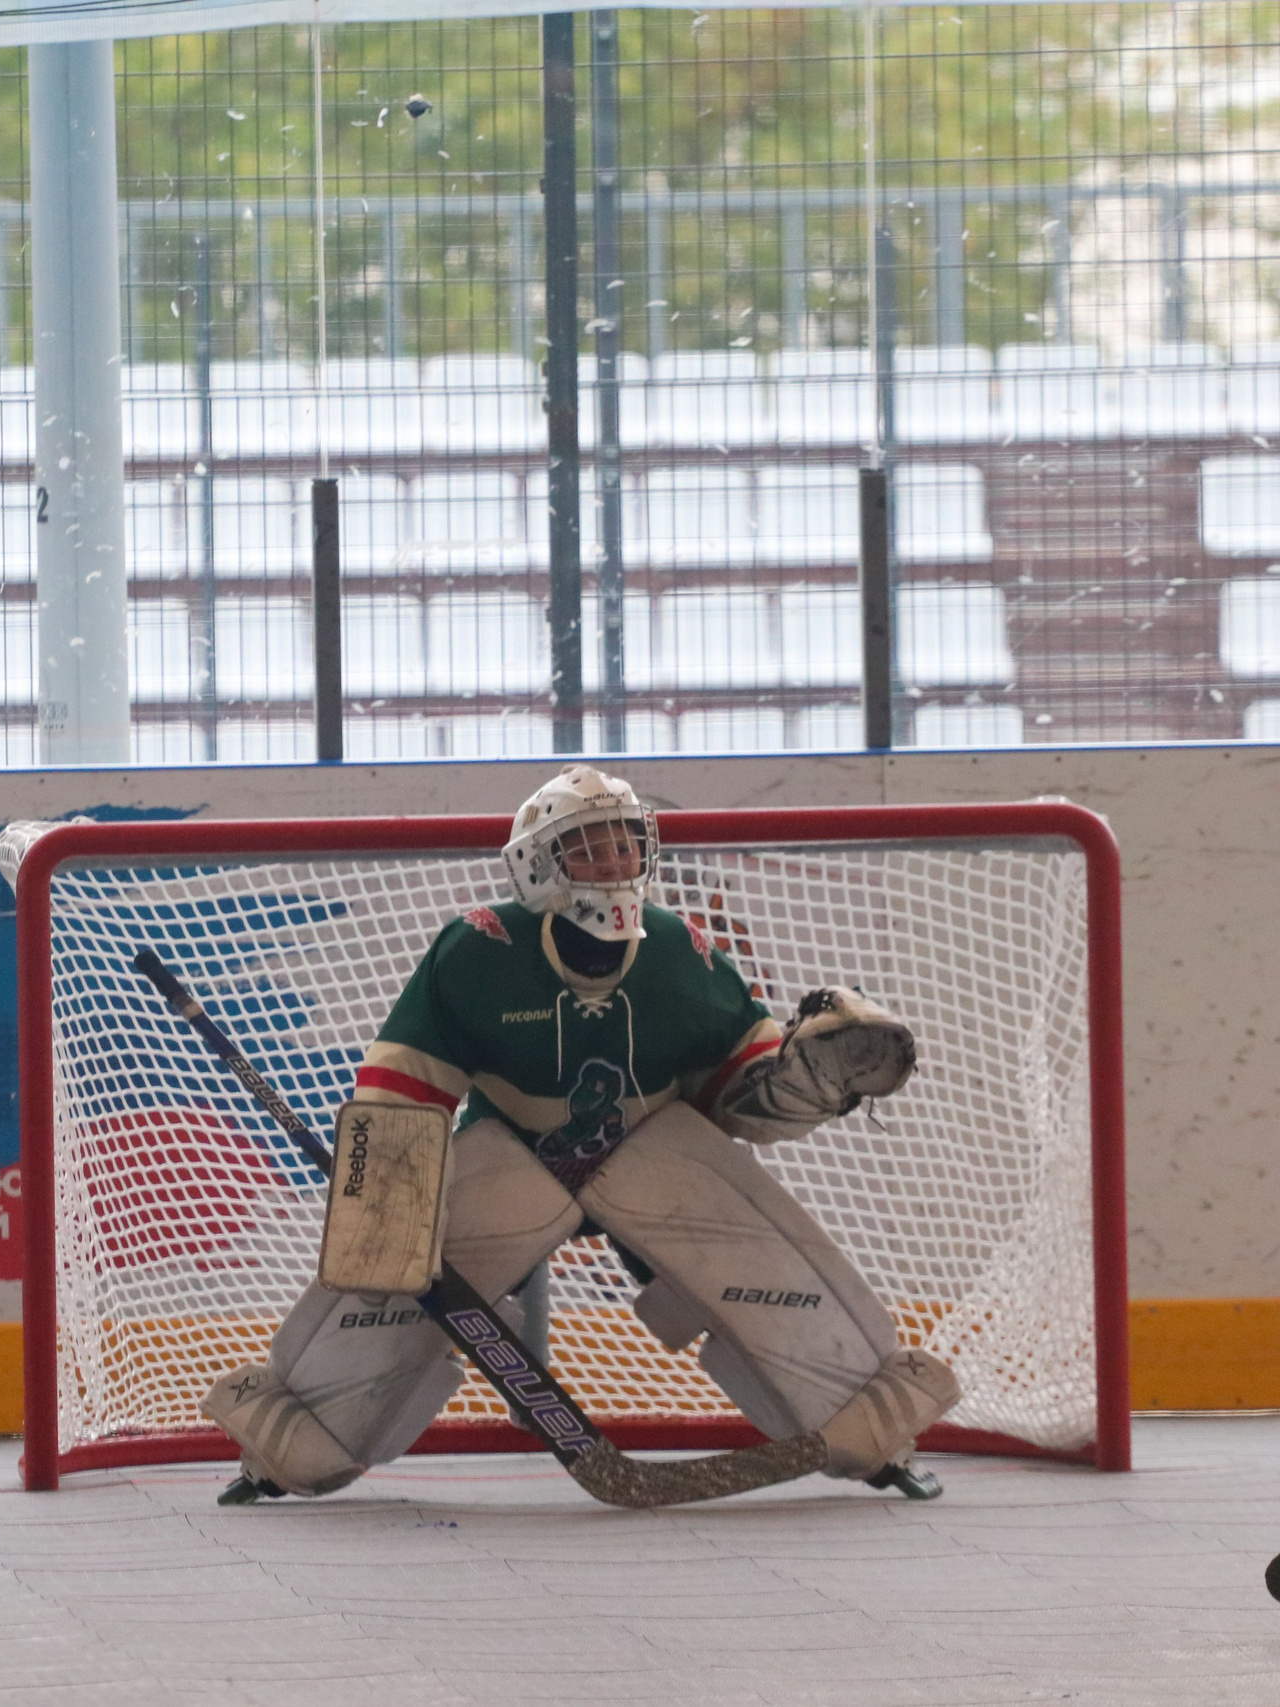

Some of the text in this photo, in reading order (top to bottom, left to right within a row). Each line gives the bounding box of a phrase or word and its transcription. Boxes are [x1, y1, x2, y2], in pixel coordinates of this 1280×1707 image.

[611, 904, 639, 931] 32
[502, 1008, 554, 1024] РУСФЛАГ
[343, 1118, 371, 1198] Reebok
